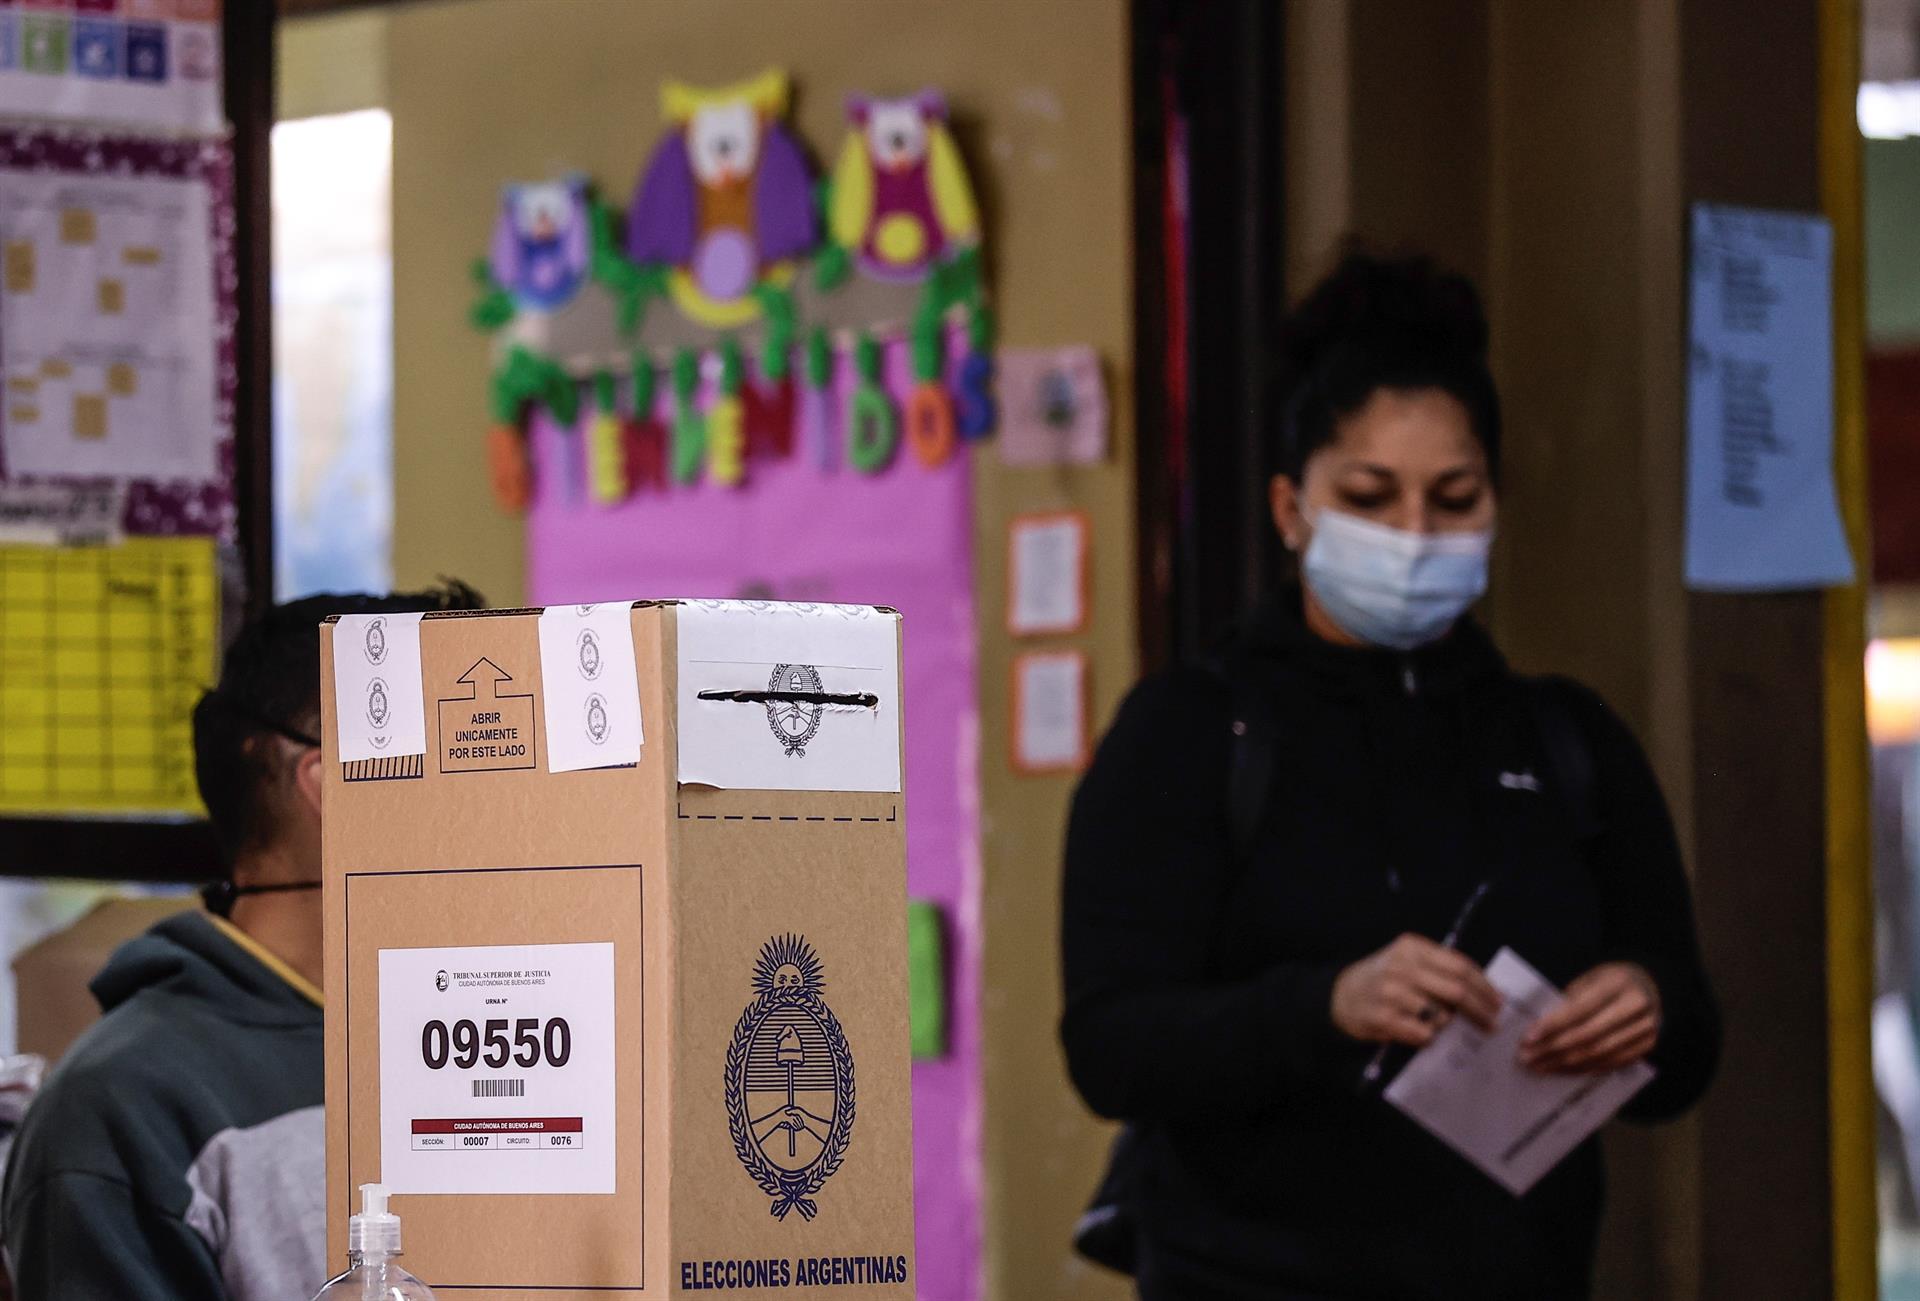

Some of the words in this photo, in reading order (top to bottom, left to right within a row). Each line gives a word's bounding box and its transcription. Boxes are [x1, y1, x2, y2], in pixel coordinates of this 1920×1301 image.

[471, 712, 501, 724] ABRIR
[455, 728, 518, 742] UNICAMENTE
[449, 747, 469, 759] POR
[472, 746, 496, 758] ESTE
[499, 744, 525, 757] LADO
[524, 970, 551, 978] JUSTICIA
[422, 1017, 571, 1070] 09550
[473, 1121, 500, 1129] AUTÓNOMA
[529, 1121, 544, 1129] AIRES
[463, 1137, 489, 1146] 00007
[550, 1136, 572, 1145] 0076
[681, 1259, 791, 1290] ELECCIONES
[795, 1255, 907, 1286] ARGENTINAS
